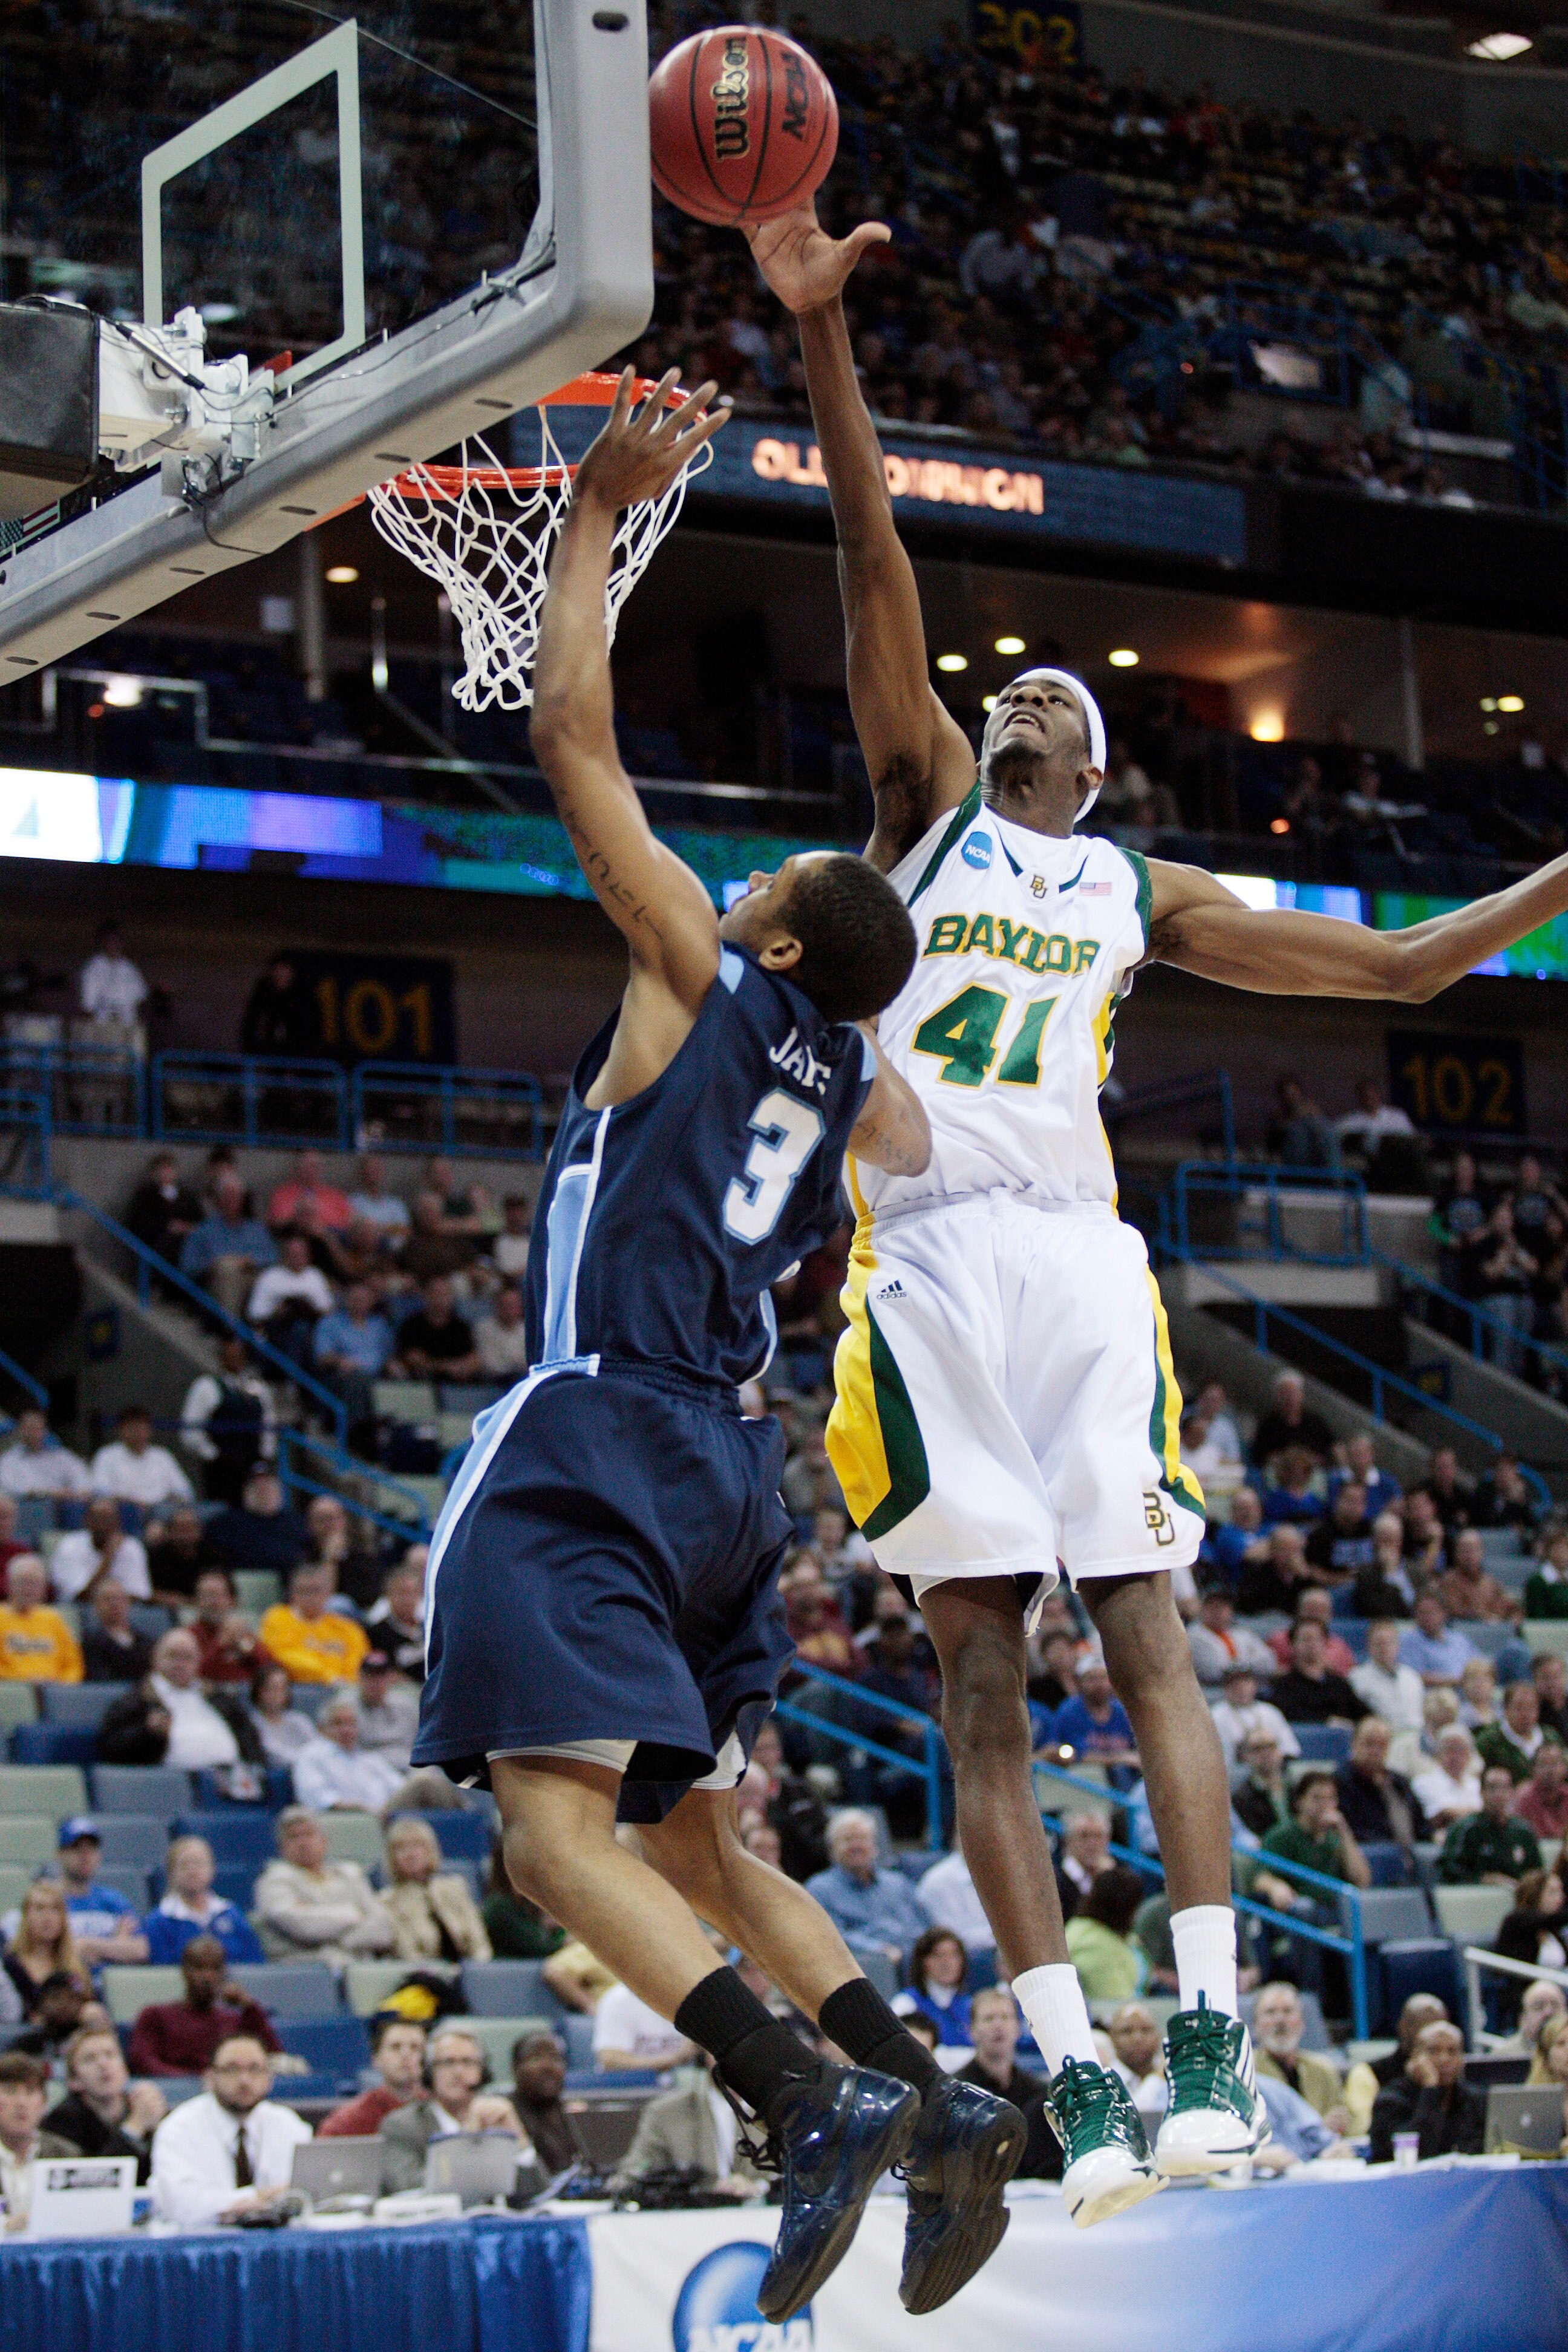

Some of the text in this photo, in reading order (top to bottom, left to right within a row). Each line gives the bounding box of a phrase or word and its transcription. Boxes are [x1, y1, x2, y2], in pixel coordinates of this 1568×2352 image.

[711, 36, 750, 162] Wilson
[782, 51, 809, 143] NCAA
[965, 844, 990, 864] NCAA
[921, 911, 1100, 978] BAYLOR
[313, 976, 433, 1056] 101
[909, 981, 1062, 1090] 41
[1401, 1054, 1512, 1123] 102
[722, 1088, 827, 1246] 3
